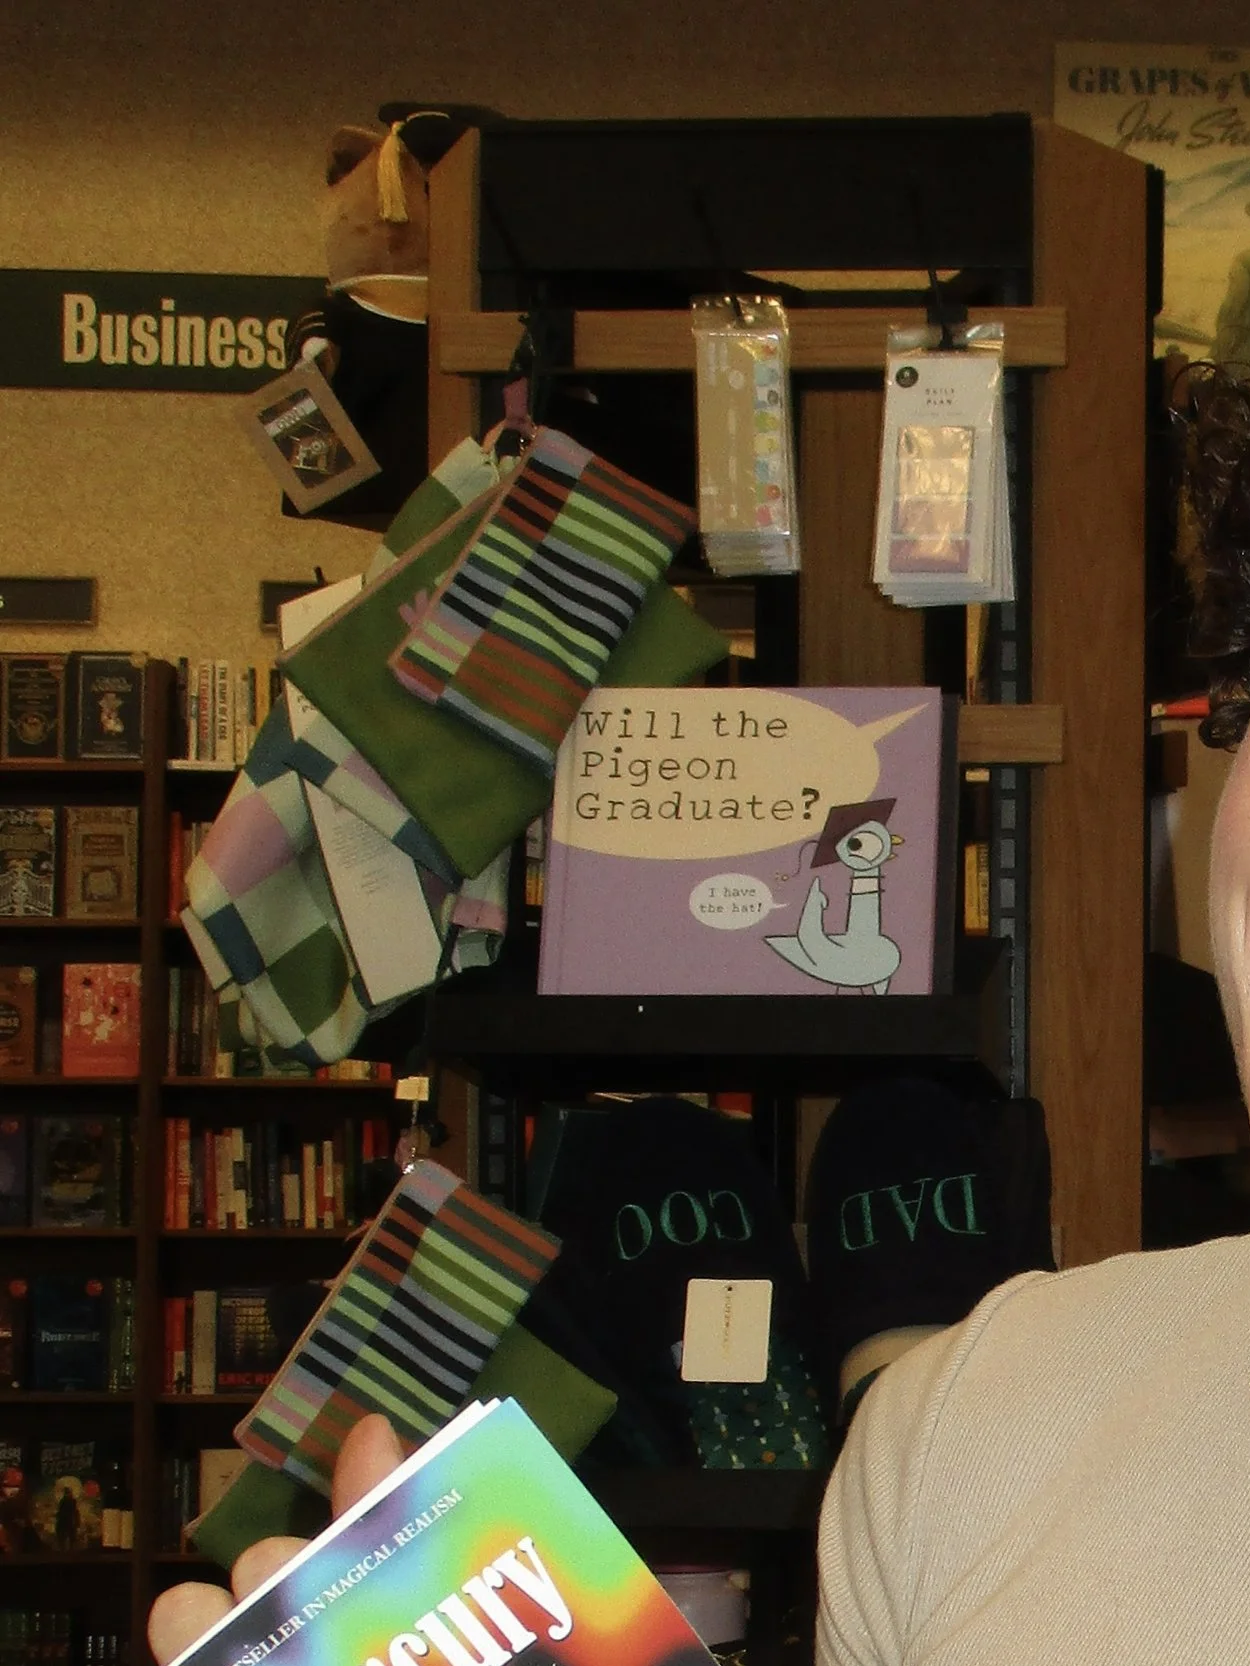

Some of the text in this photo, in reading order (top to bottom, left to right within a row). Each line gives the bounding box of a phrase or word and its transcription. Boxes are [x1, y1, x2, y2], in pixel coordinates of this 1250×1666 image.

[1067, 66, 1210, 98] GRAPES
[1112, 100, 1181, 152] John
[62, 292, 289, 371] Business
[580, 707, 788, 740] Will the
[580, 746, 738, 787] Pigeon
[575, 787, 820, 821] Graduate?
[699, 902, 763, 913] the hat!
[708, 885, 757, 898] I have
[840, 1173, 987, 1251] DAD
[303, 1598, 331, 1621] IN
[323, 1543, 399, 1607] MAGICAL
[393, 1489, 464, 1551] REALISM
